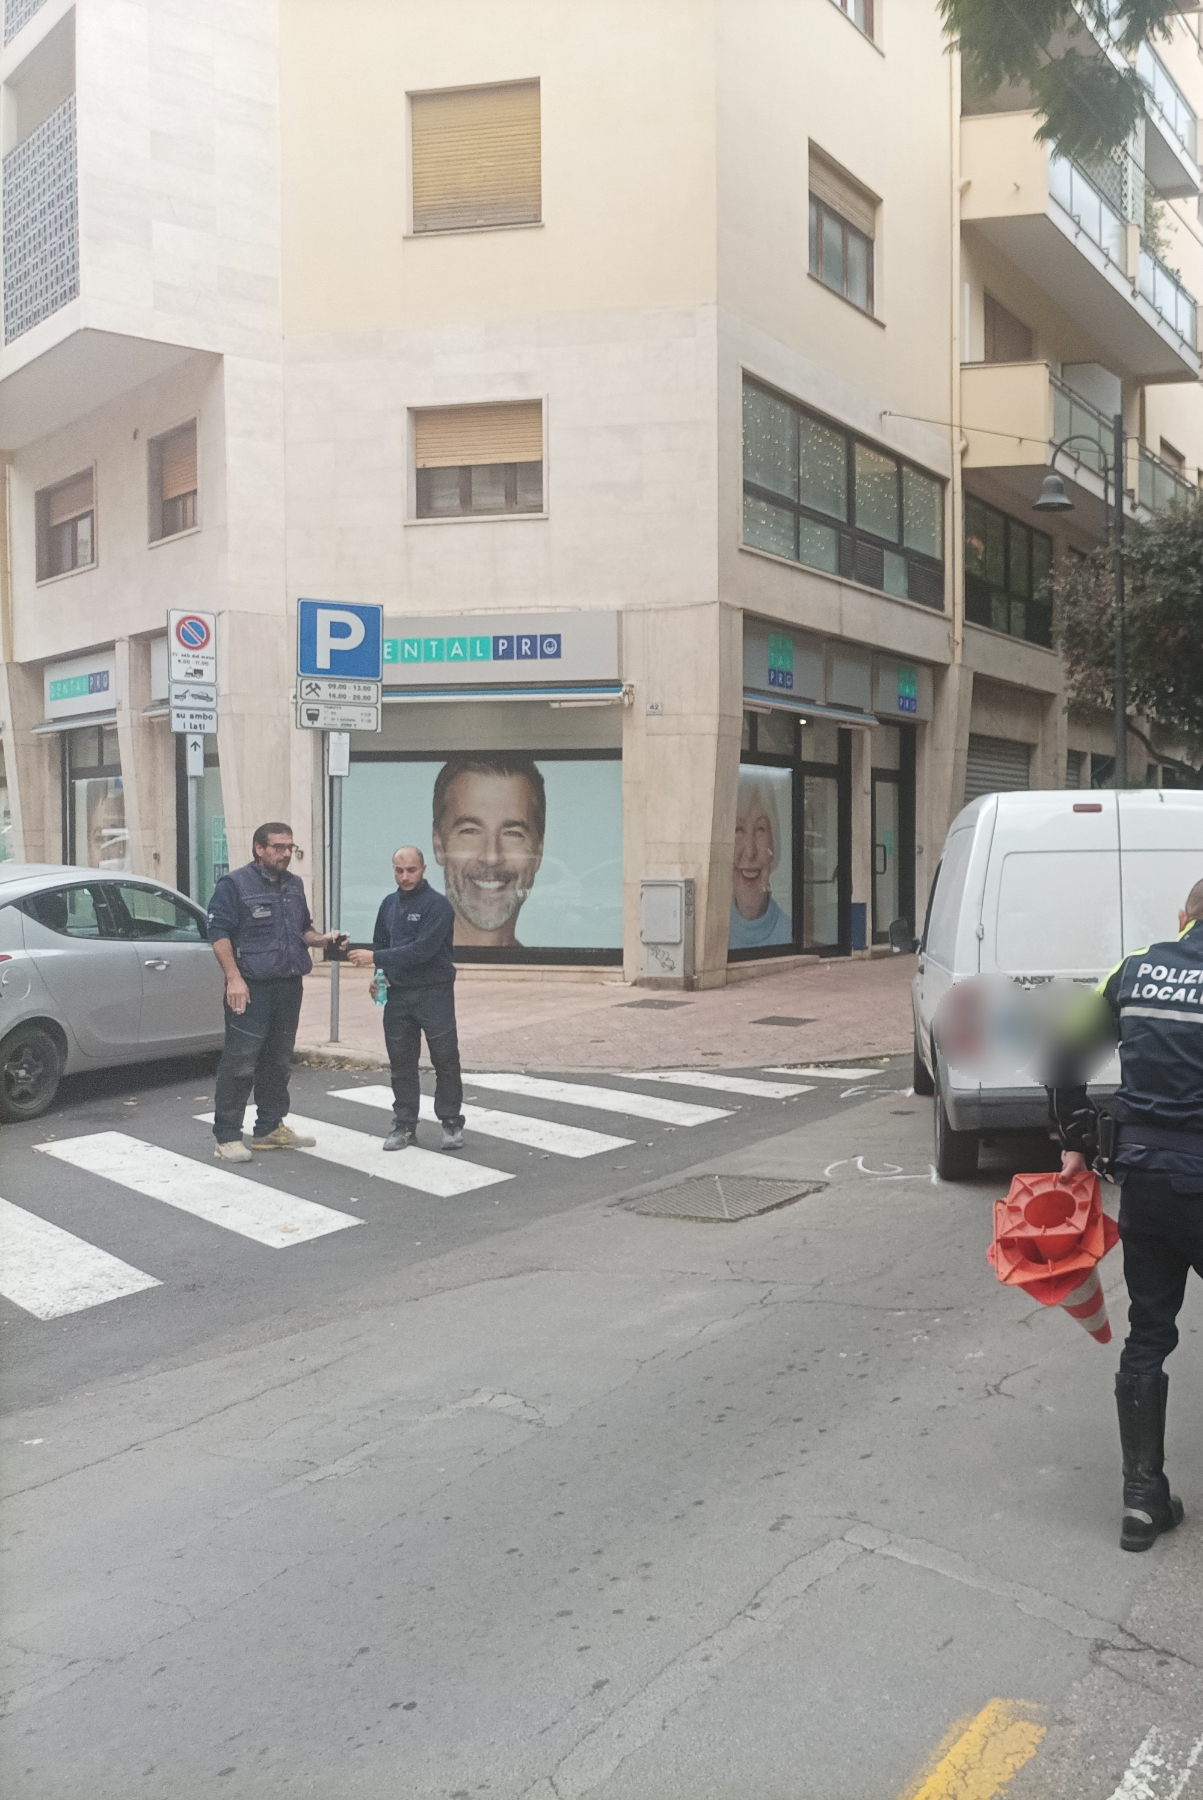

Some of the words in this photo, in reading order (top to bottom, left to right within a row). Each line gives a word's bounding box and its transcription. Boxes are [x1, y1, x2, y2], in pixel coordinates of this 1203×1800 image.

[316, 608, 366, 669] P
[383, 637, 559, 660] ENTALPRO
[770, 670, 793, 687] PRO
[189, 713, 213, 721] ambo
